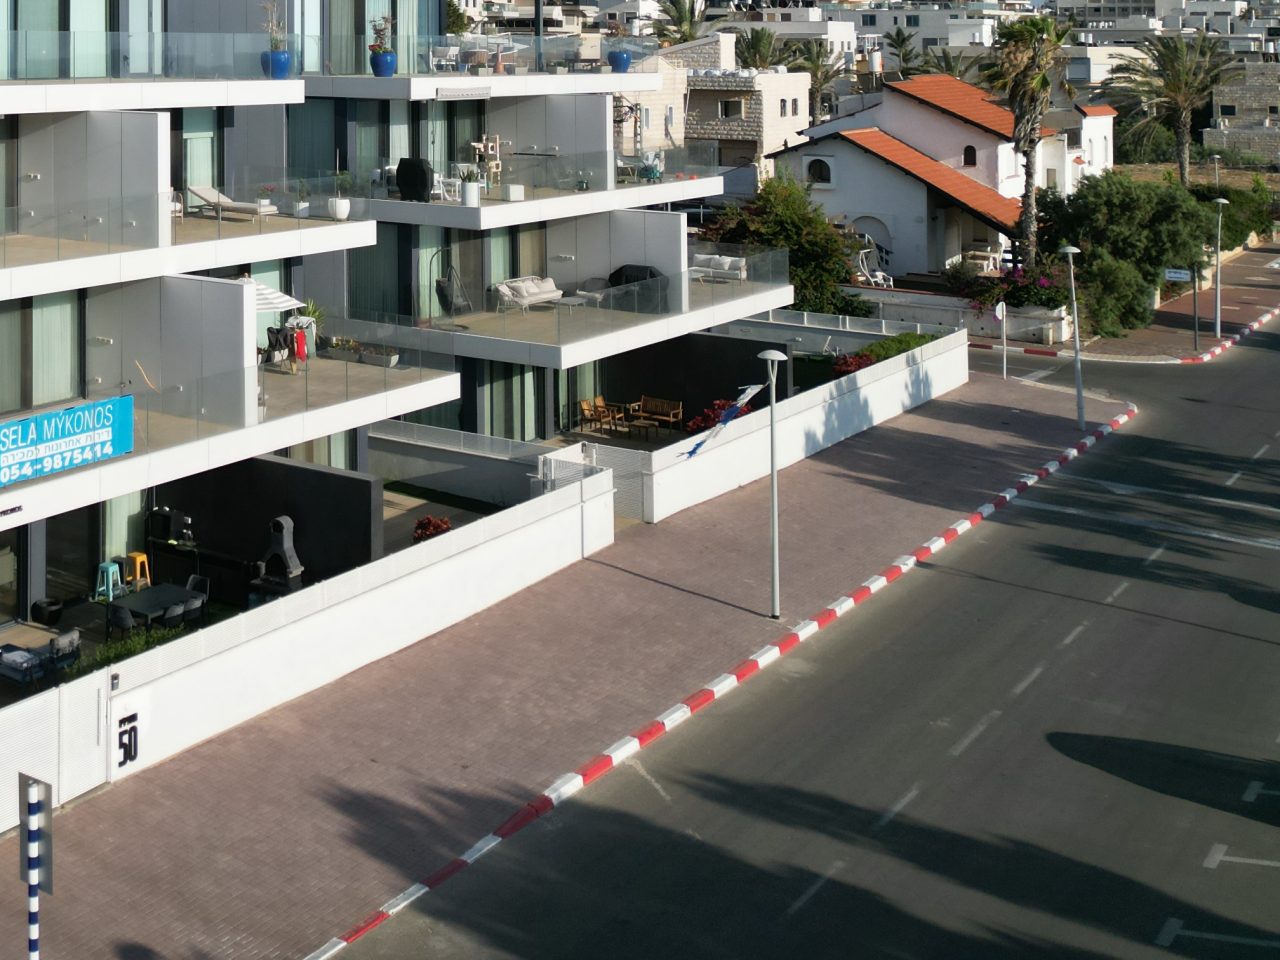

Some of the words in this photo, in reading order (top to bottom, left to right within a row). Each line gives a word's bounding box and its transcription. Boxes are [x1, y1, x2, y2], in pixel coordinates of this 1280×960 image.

[0, 423, 36, 451] SELA
[0, 441, 113, 483] 054-9875414
[118, 725, 138, 768] 50
